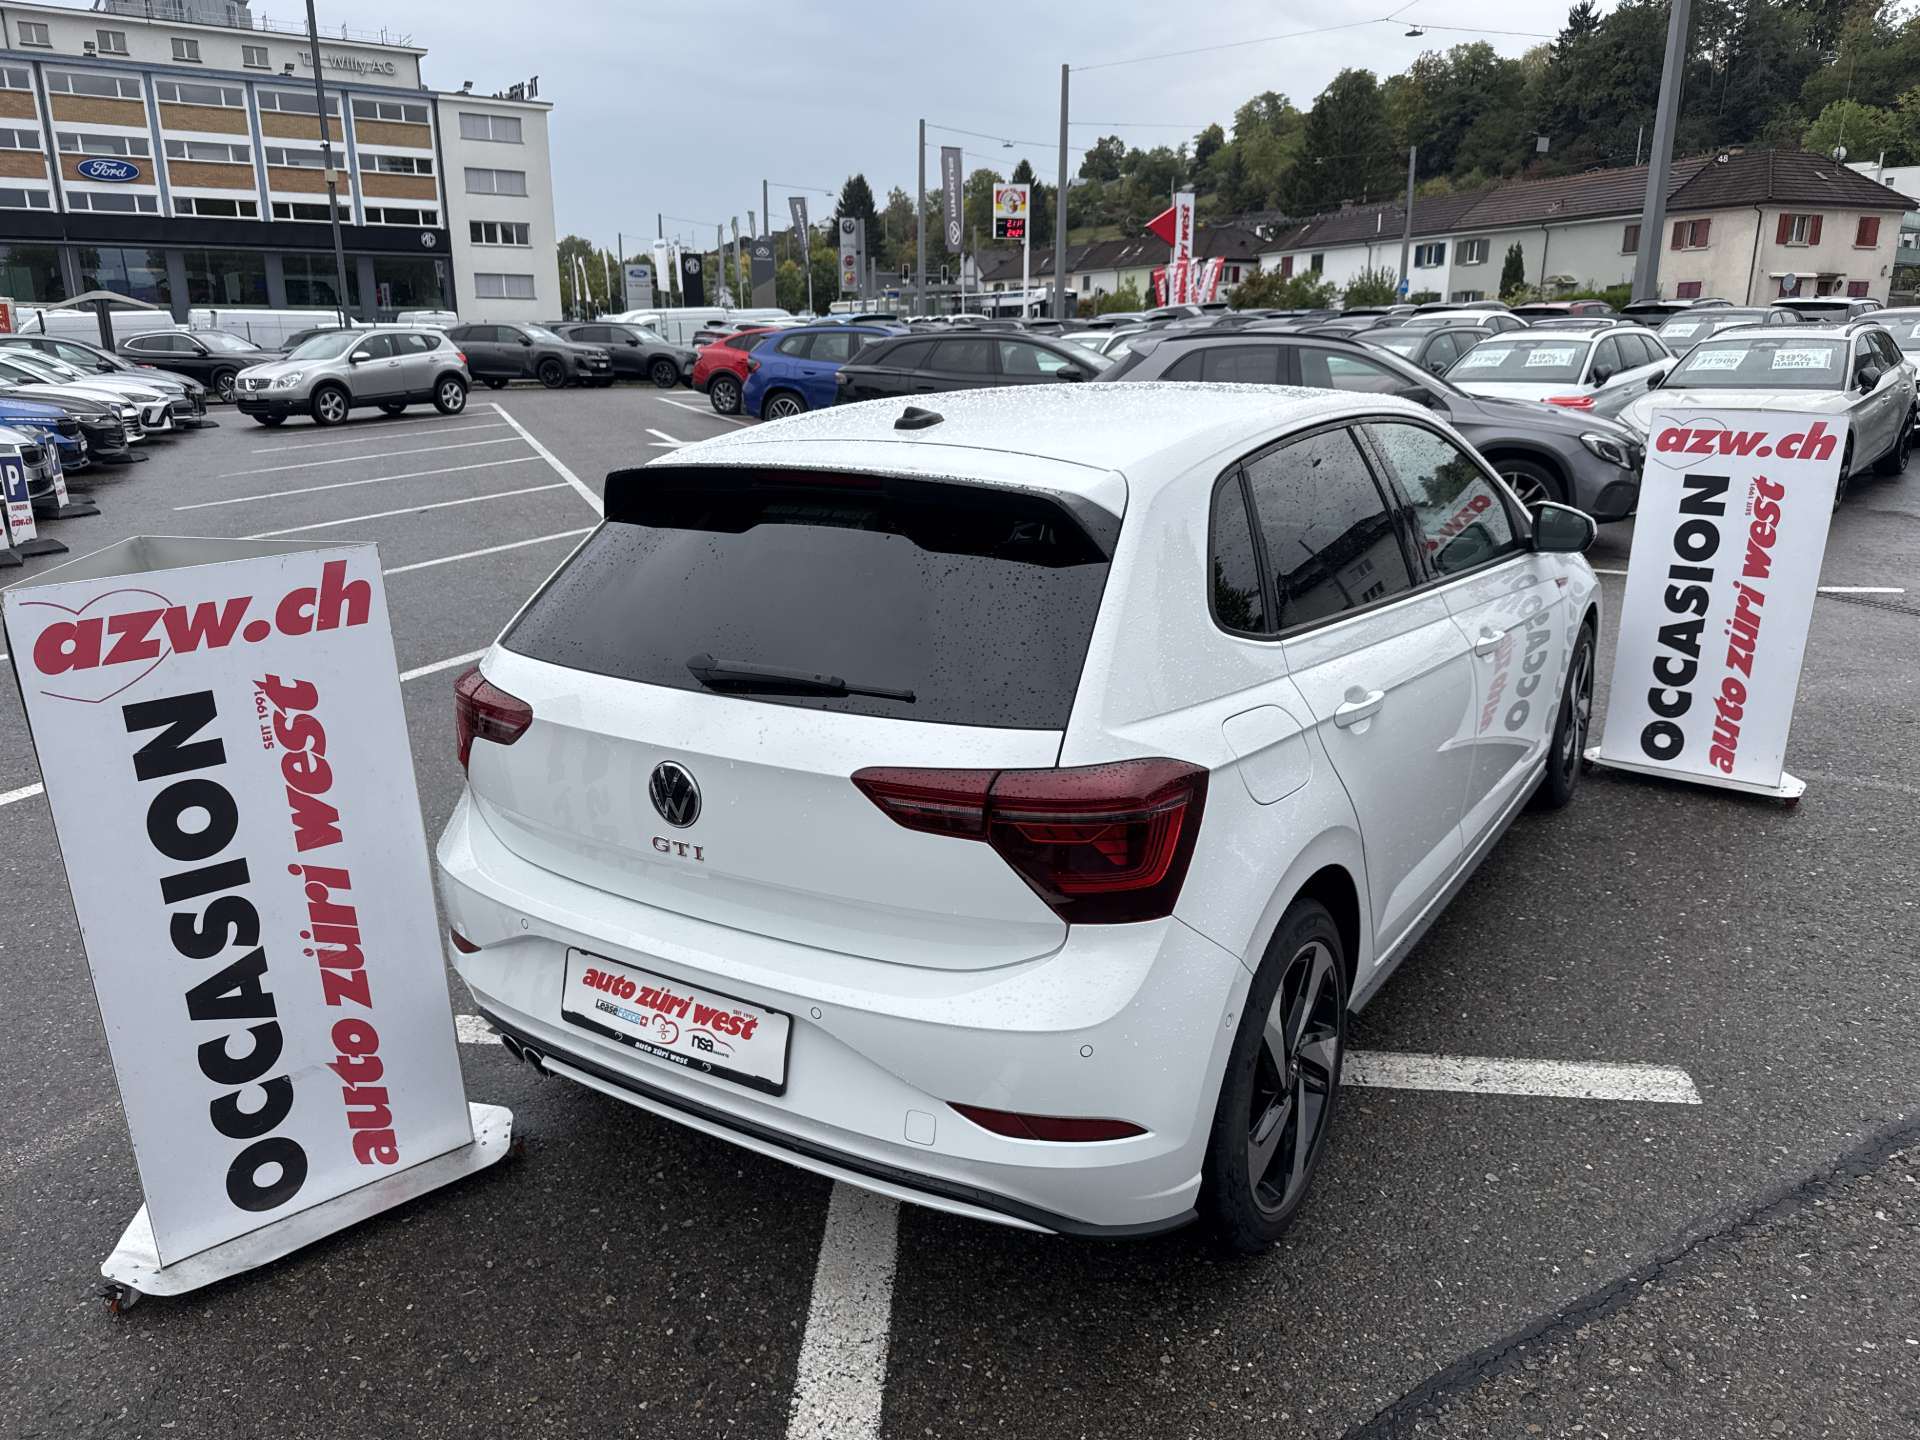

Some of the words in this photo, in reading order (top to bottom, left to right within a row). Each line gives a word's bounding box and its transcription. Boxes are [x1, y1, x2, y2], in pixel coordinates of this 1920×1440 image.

[329, 55, 366, 76] Willy
[371, 60, 395, 75] AG
[90, 161, 127, 177] Ford
[1656, 421, 1837, 460] azw.ch
[6, 465, 19, 496] P
[1742, 474, 1785, 578] west
[33, 559, 372, 675] azw.ch
[1640, 474, 1730, 761] OCCASION
[1723, 580, 1765, 679] züri
[254, 690, 269, 721] 1991
[1709, 676, 1747, 774] auto
[252, 674, 344, 853] west
[260, 724, 274, 750] SEIT
[652, 836, 705, 861] GTI
[122, 690, 308, 1212] OCCASION
[288, 864, 373, 1009] züri
[582, 967, 637, 999] auto
[634, 986, 694, 1019] züri
[693, 1003, 759, 1040] west
[595, 999, 640, 1025] LeaseForce
[635, 1041, 652, 1052] auto
[670, 1053, 689, 1065] west
[692, 1034, 714, 1053] nsa
[326, 1018, 400, 1165] auto
